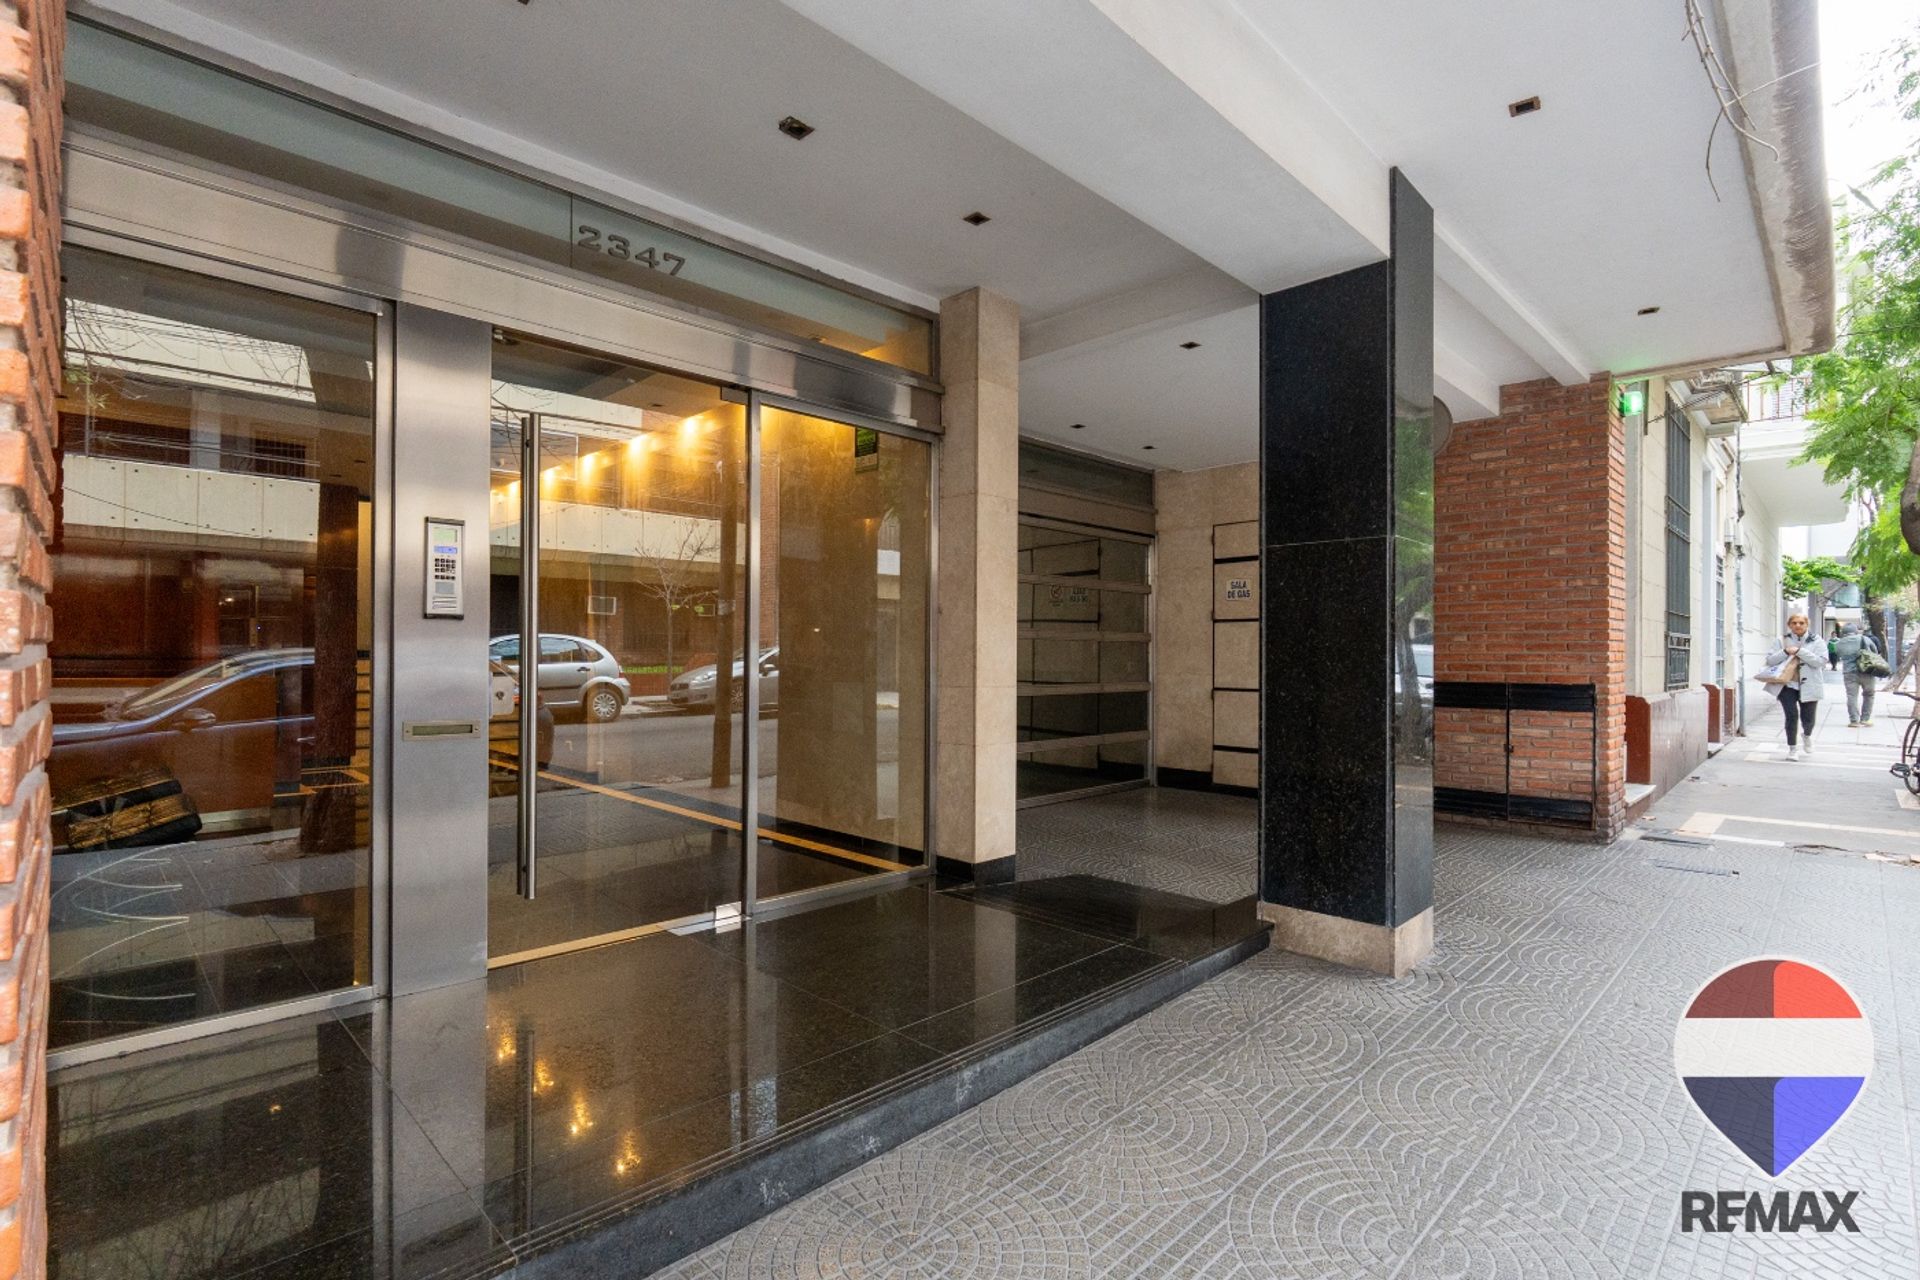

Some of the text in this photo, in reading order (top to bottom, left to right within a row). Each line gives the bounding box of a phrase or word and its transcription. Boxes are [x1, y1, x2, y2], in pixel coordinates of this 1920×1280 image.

[578, 224, 686, 276] 2347
[1231, 580, 1248, 590] SALA
[1227, 589, 1251, 599] DE GAS
